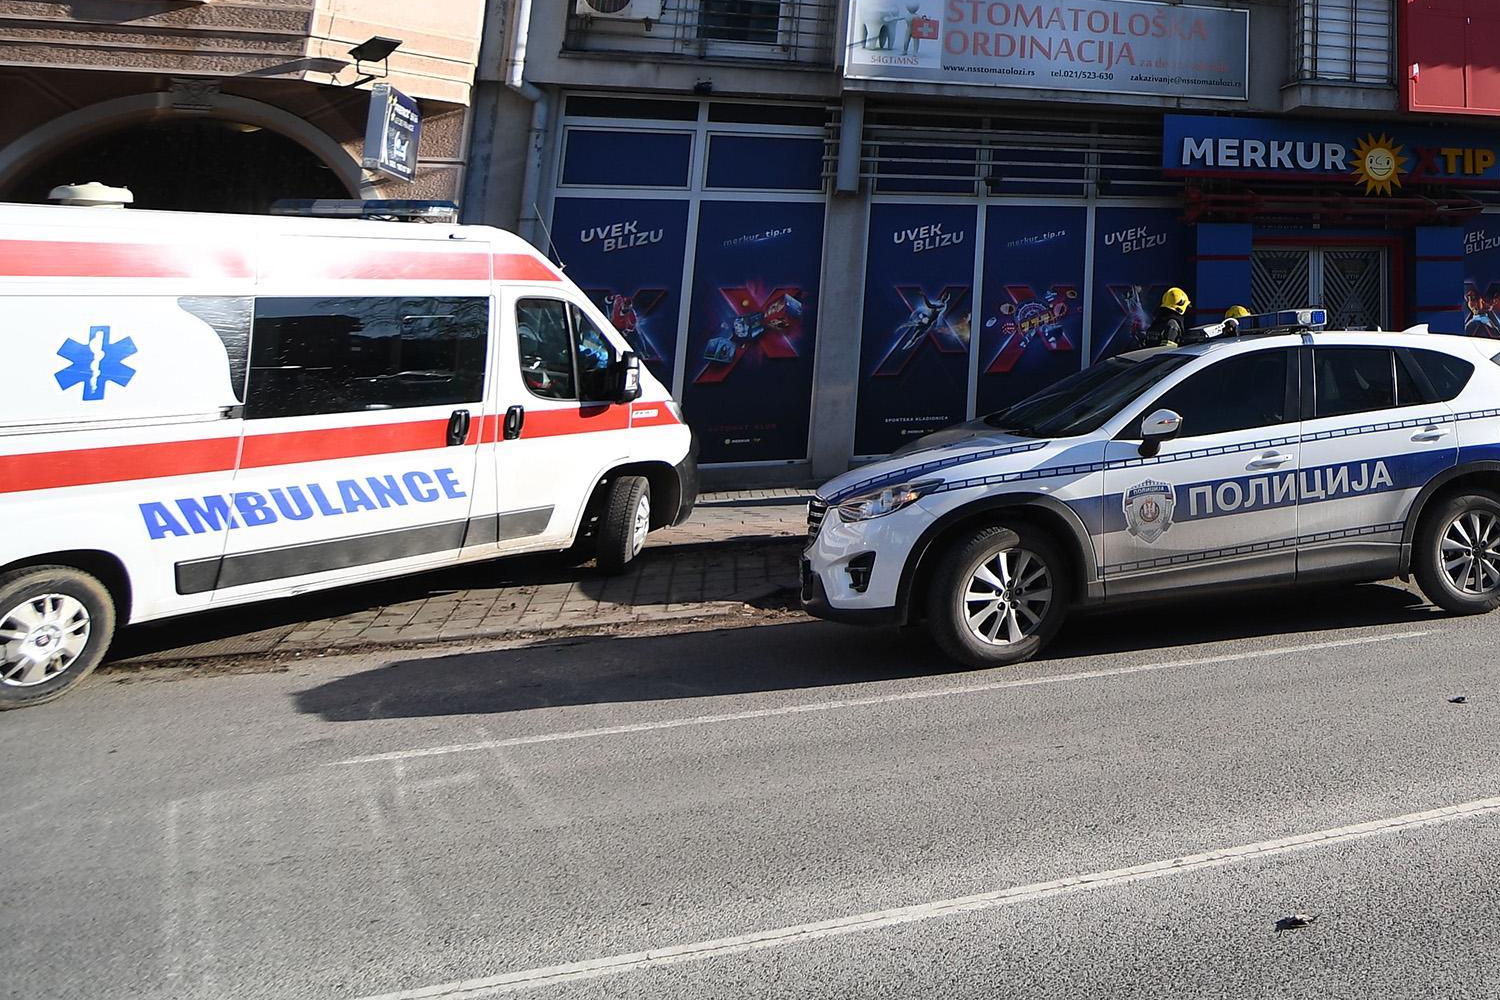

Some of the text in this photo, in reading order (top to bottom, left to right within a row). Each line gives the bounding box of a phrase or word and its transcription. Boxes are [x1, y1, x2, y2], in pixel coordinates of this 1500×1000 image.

[944, 30, 1136, 70] ORDINACIJA
[943, 64, 1036, 77] www.nsstomatolozi.rs
[1181, 136, 1347, 170] MERKUR
[580, 220, 638, 243] UVEK
[603, 229, 664, 252] BLIZU
[893, 223, 942, 244] UVEK
[913, 231, 964, 253] BLIZU
[1104, 225, 1148, 246] UVEK
[1122, 233, 1167, 254] BLIZU
[1466, 236, 1500, 255] BLIZU
[1188, 460, 1395, 516] ПОЛИЦИЈА
[138, 467, 468, 541] AMBULANCE
